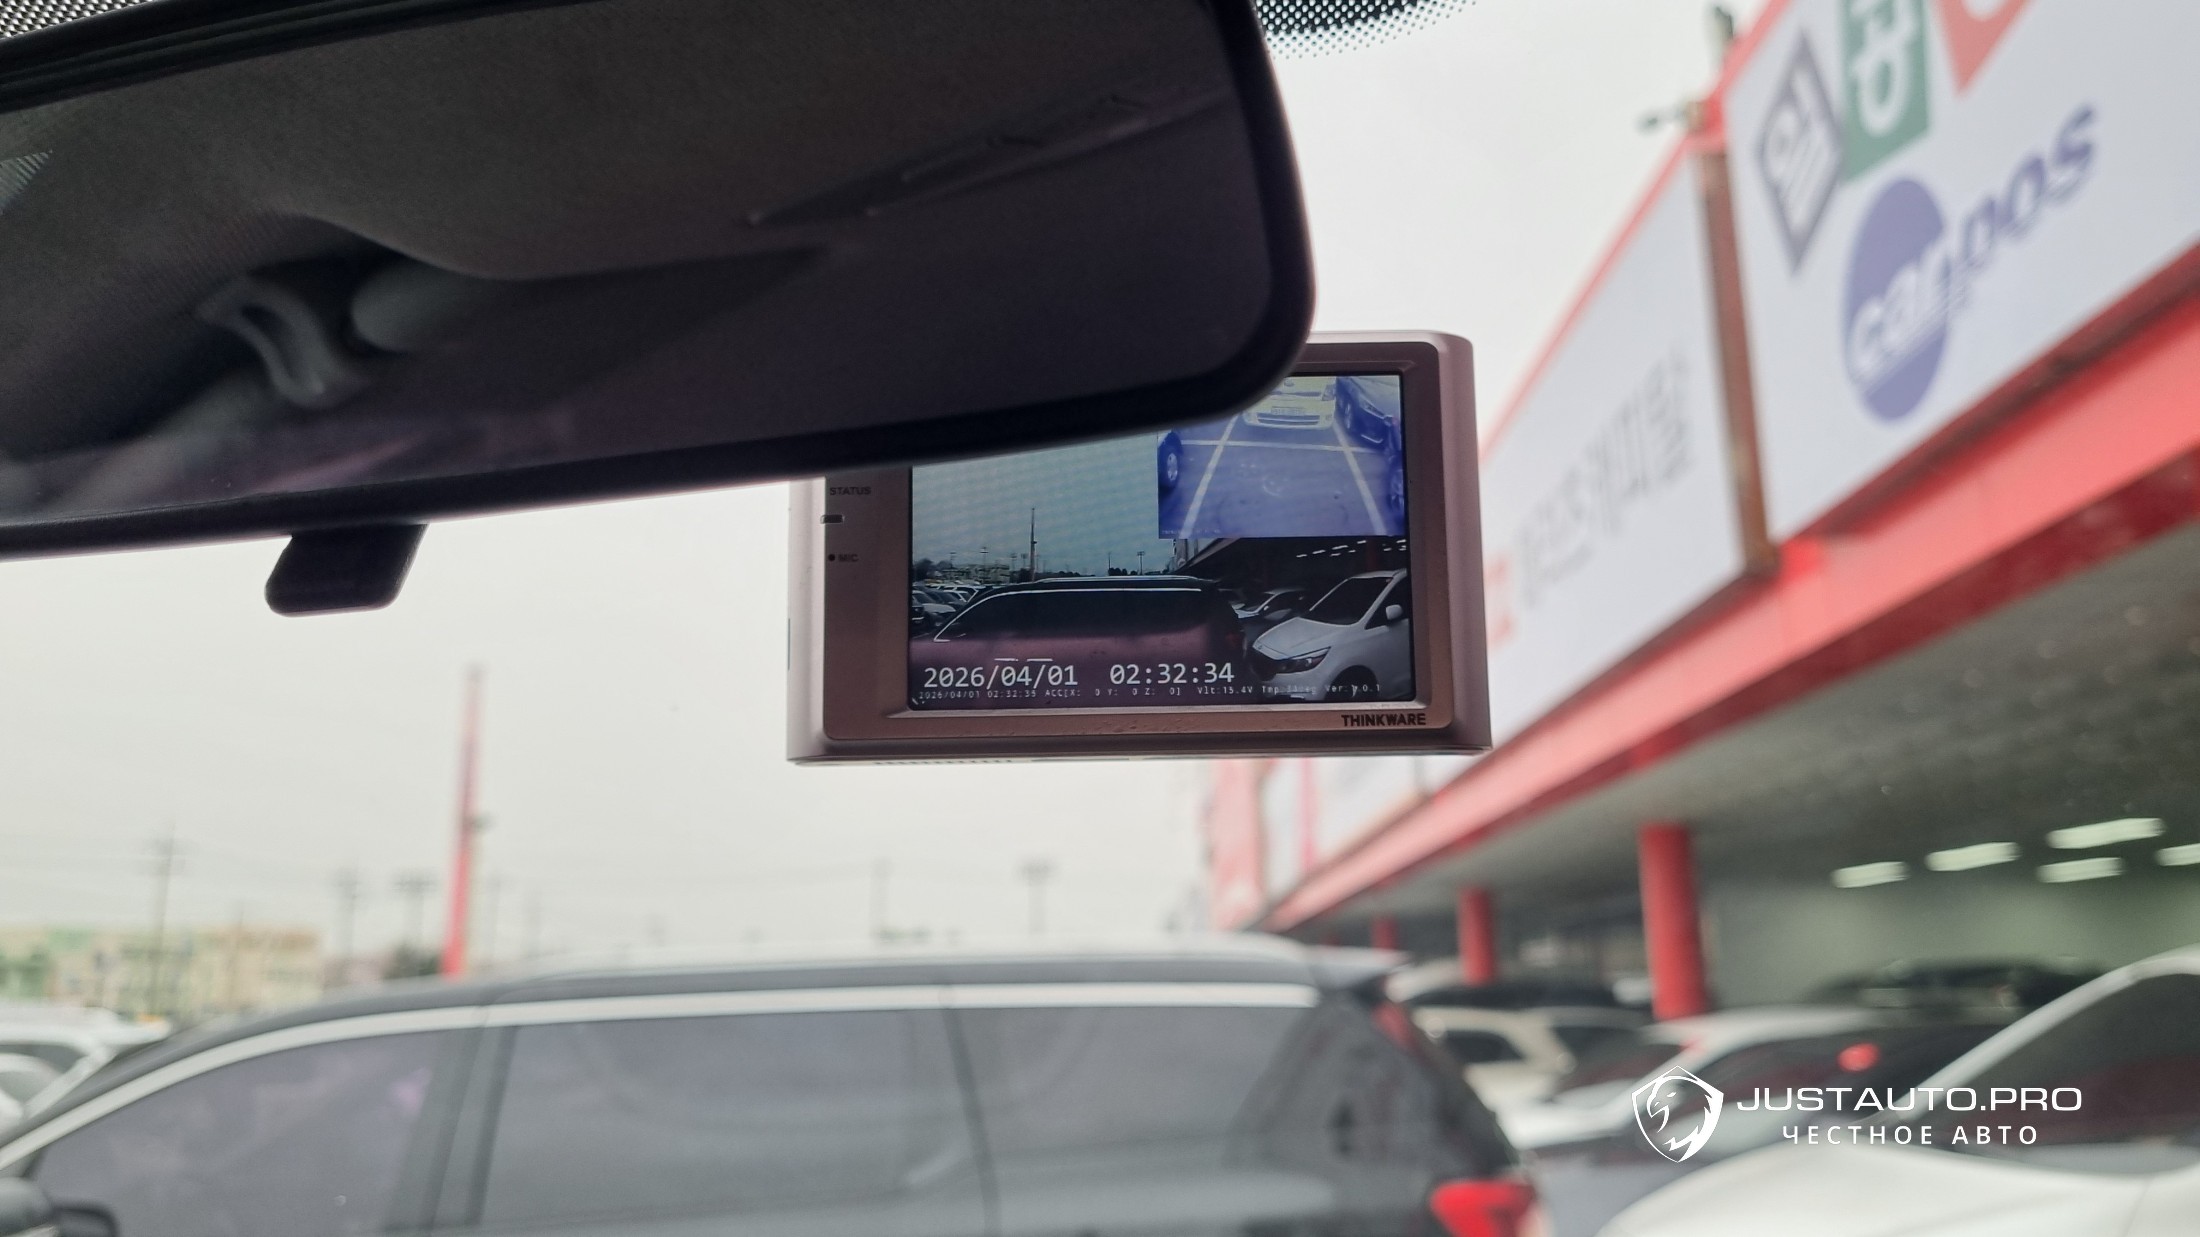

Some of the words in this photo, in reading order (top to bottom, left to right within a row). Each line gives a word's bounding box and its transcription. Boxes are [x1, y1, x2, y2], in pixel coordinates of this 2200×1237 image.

[829, 486, 872, 496] STATUS
[838, 553, 859, 562] MIC
[923, 665, 1079, 689] 2026/04/01
[1109, 662, 1236, 685] 02:32:34
[918, 690, 980, 699] 2026/04/01
[1341, 713, 1427, 727] THINKWARE
